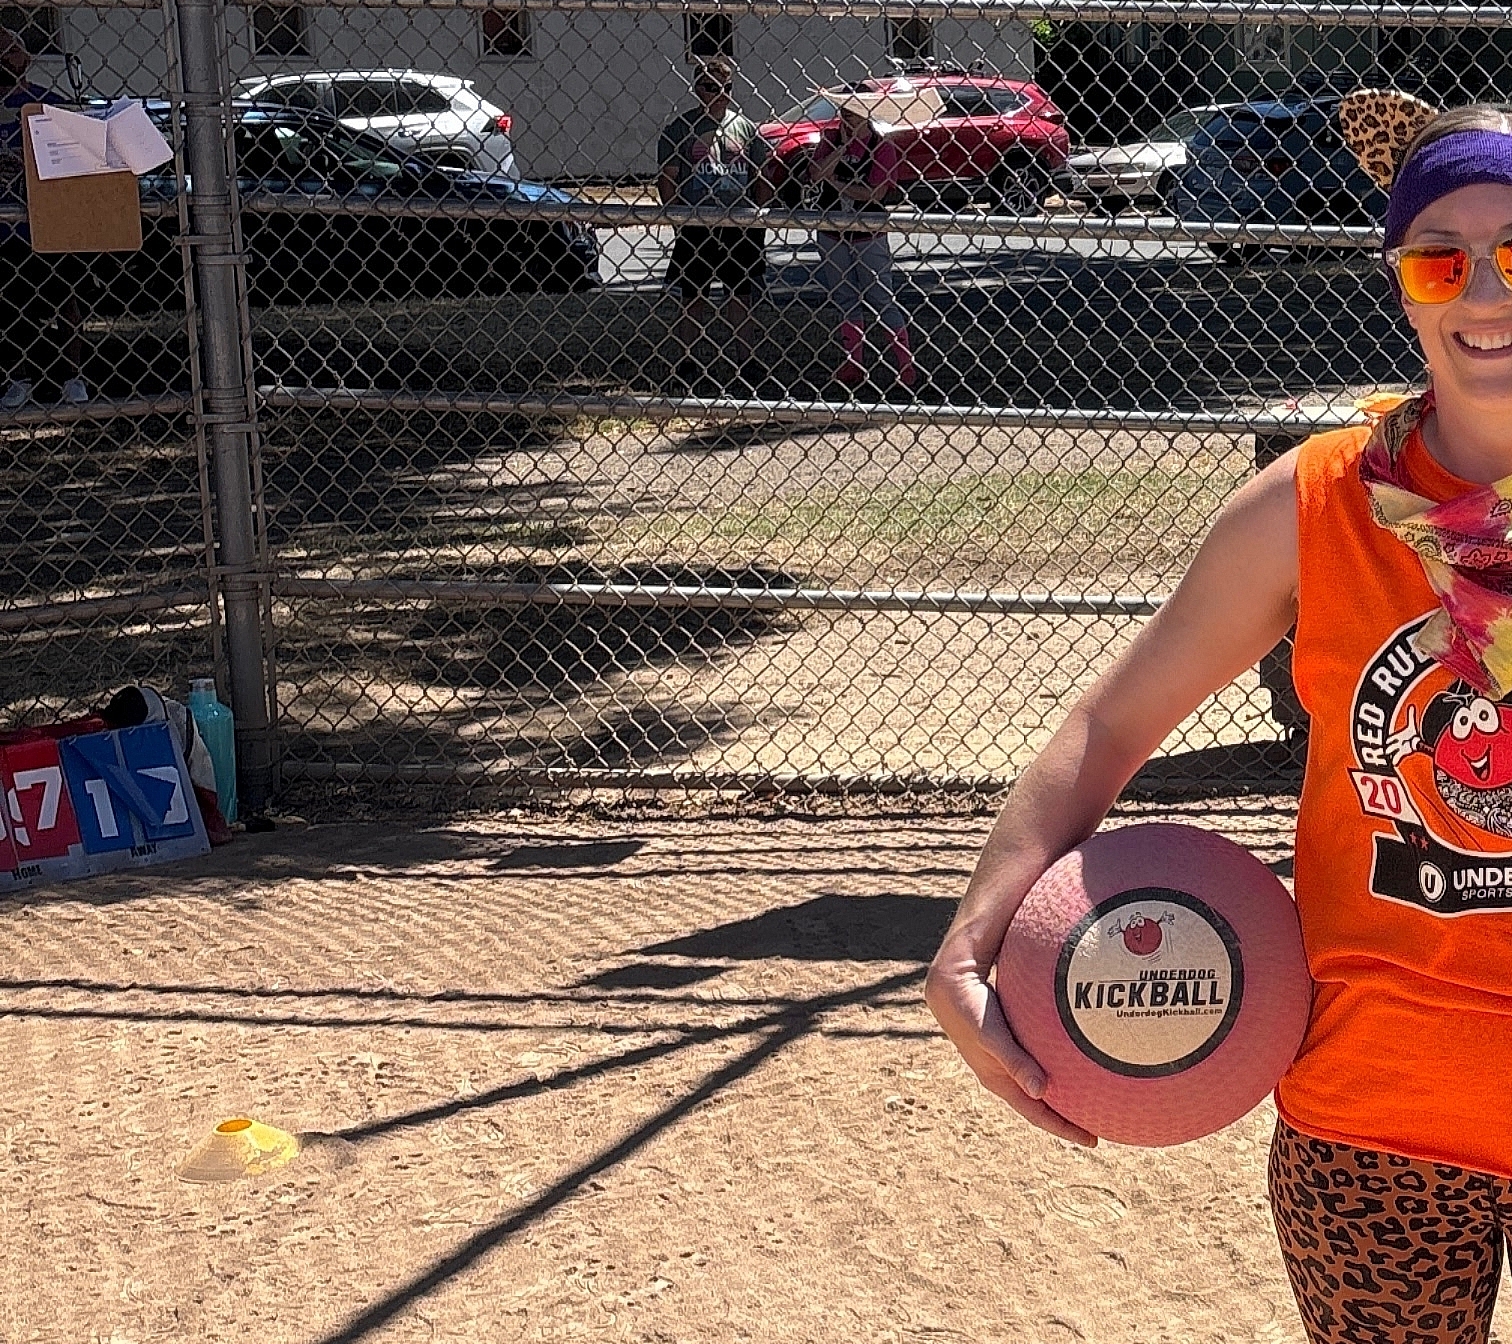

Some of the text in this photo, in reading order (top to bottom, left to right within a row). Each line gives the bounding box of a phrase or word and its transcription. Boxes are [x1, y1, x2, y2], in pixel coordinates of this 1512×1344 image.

[692, 161, 748, 176] ICKBALL
[1357, 702, 1388, 767] RED
[1360, 775, 1400, 815] 20
[1462, 887, 1512, 900] SPORTS
[1139, 968, 1217, 981] UNDERDOG
[1074, 981, 1224, 1009] KICKBALL
